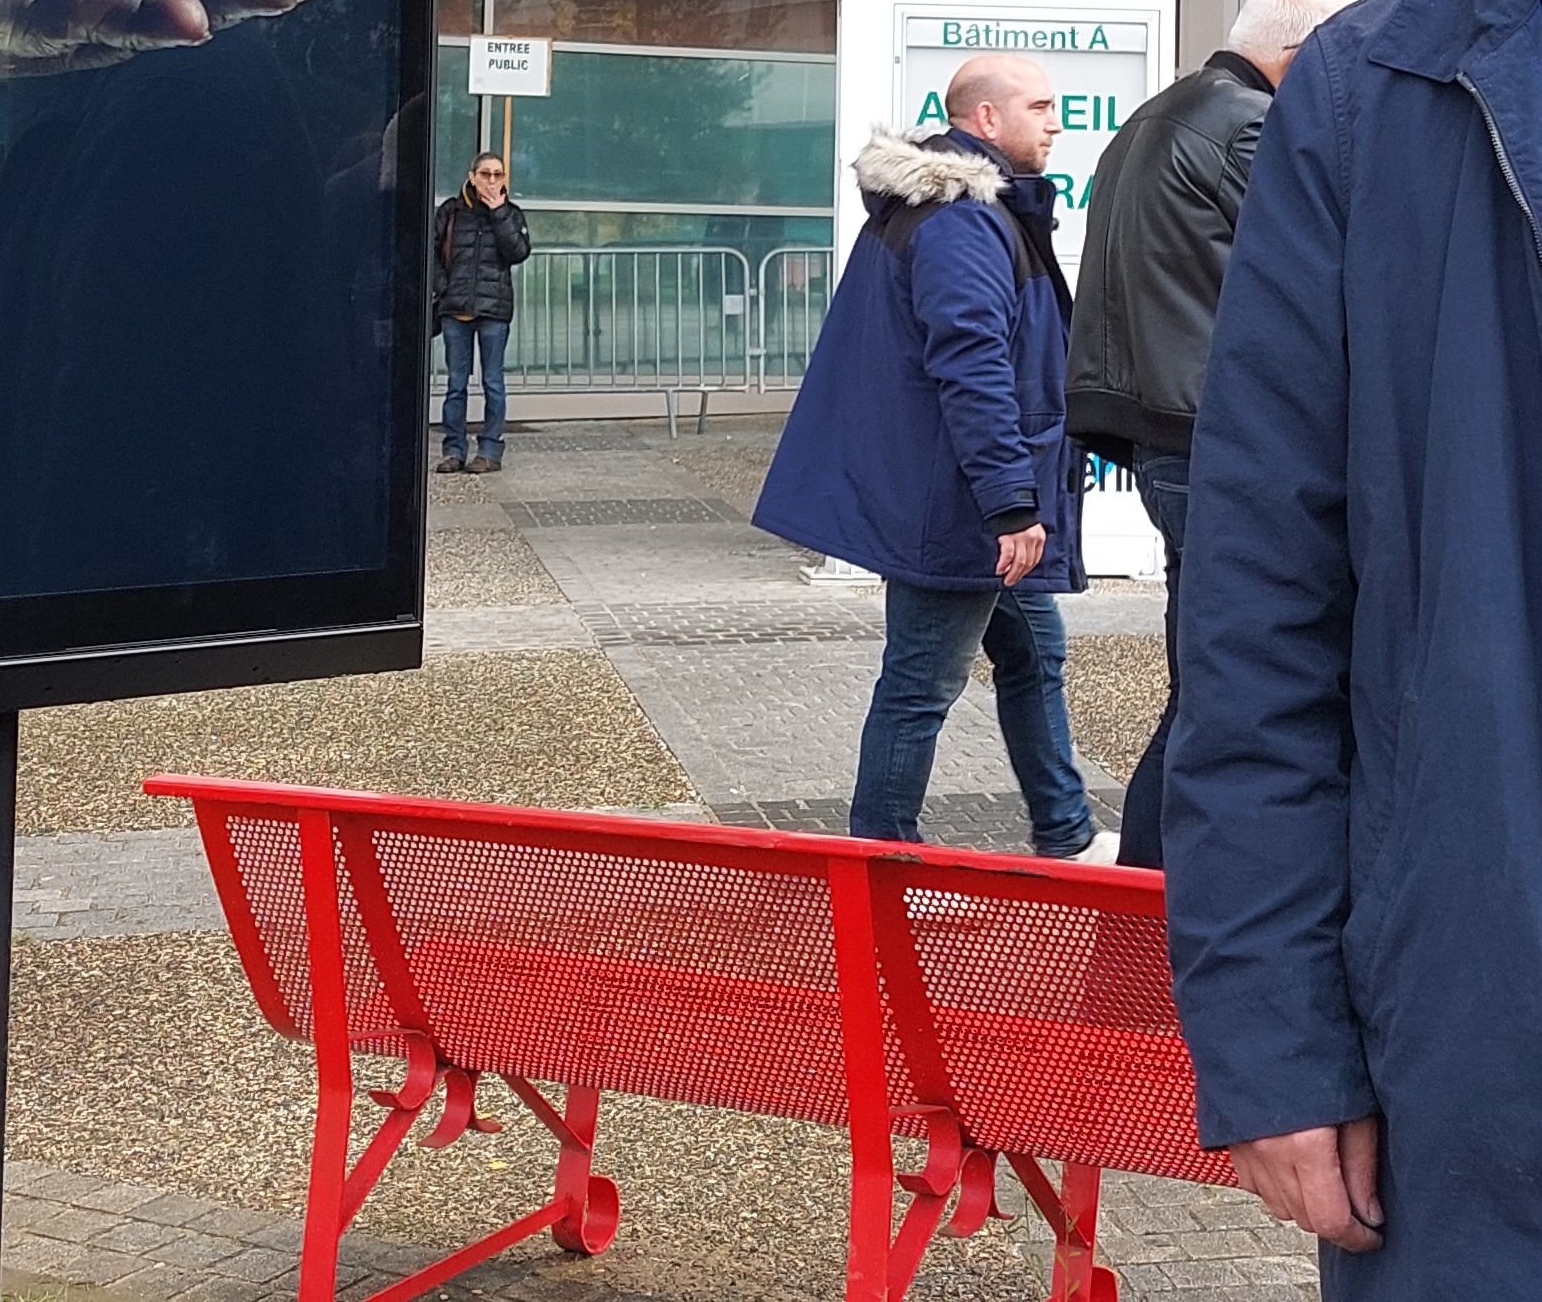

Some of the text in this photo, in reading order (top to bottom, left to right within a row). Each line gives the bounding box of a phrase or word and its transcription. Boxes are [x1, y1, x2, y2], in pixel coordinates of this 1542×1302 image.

[942, 21, 1110, 49] Bâtiment A
[488, 58, 529, 70] PUBLIC
[916, 90, 1122, 131] AEIL
